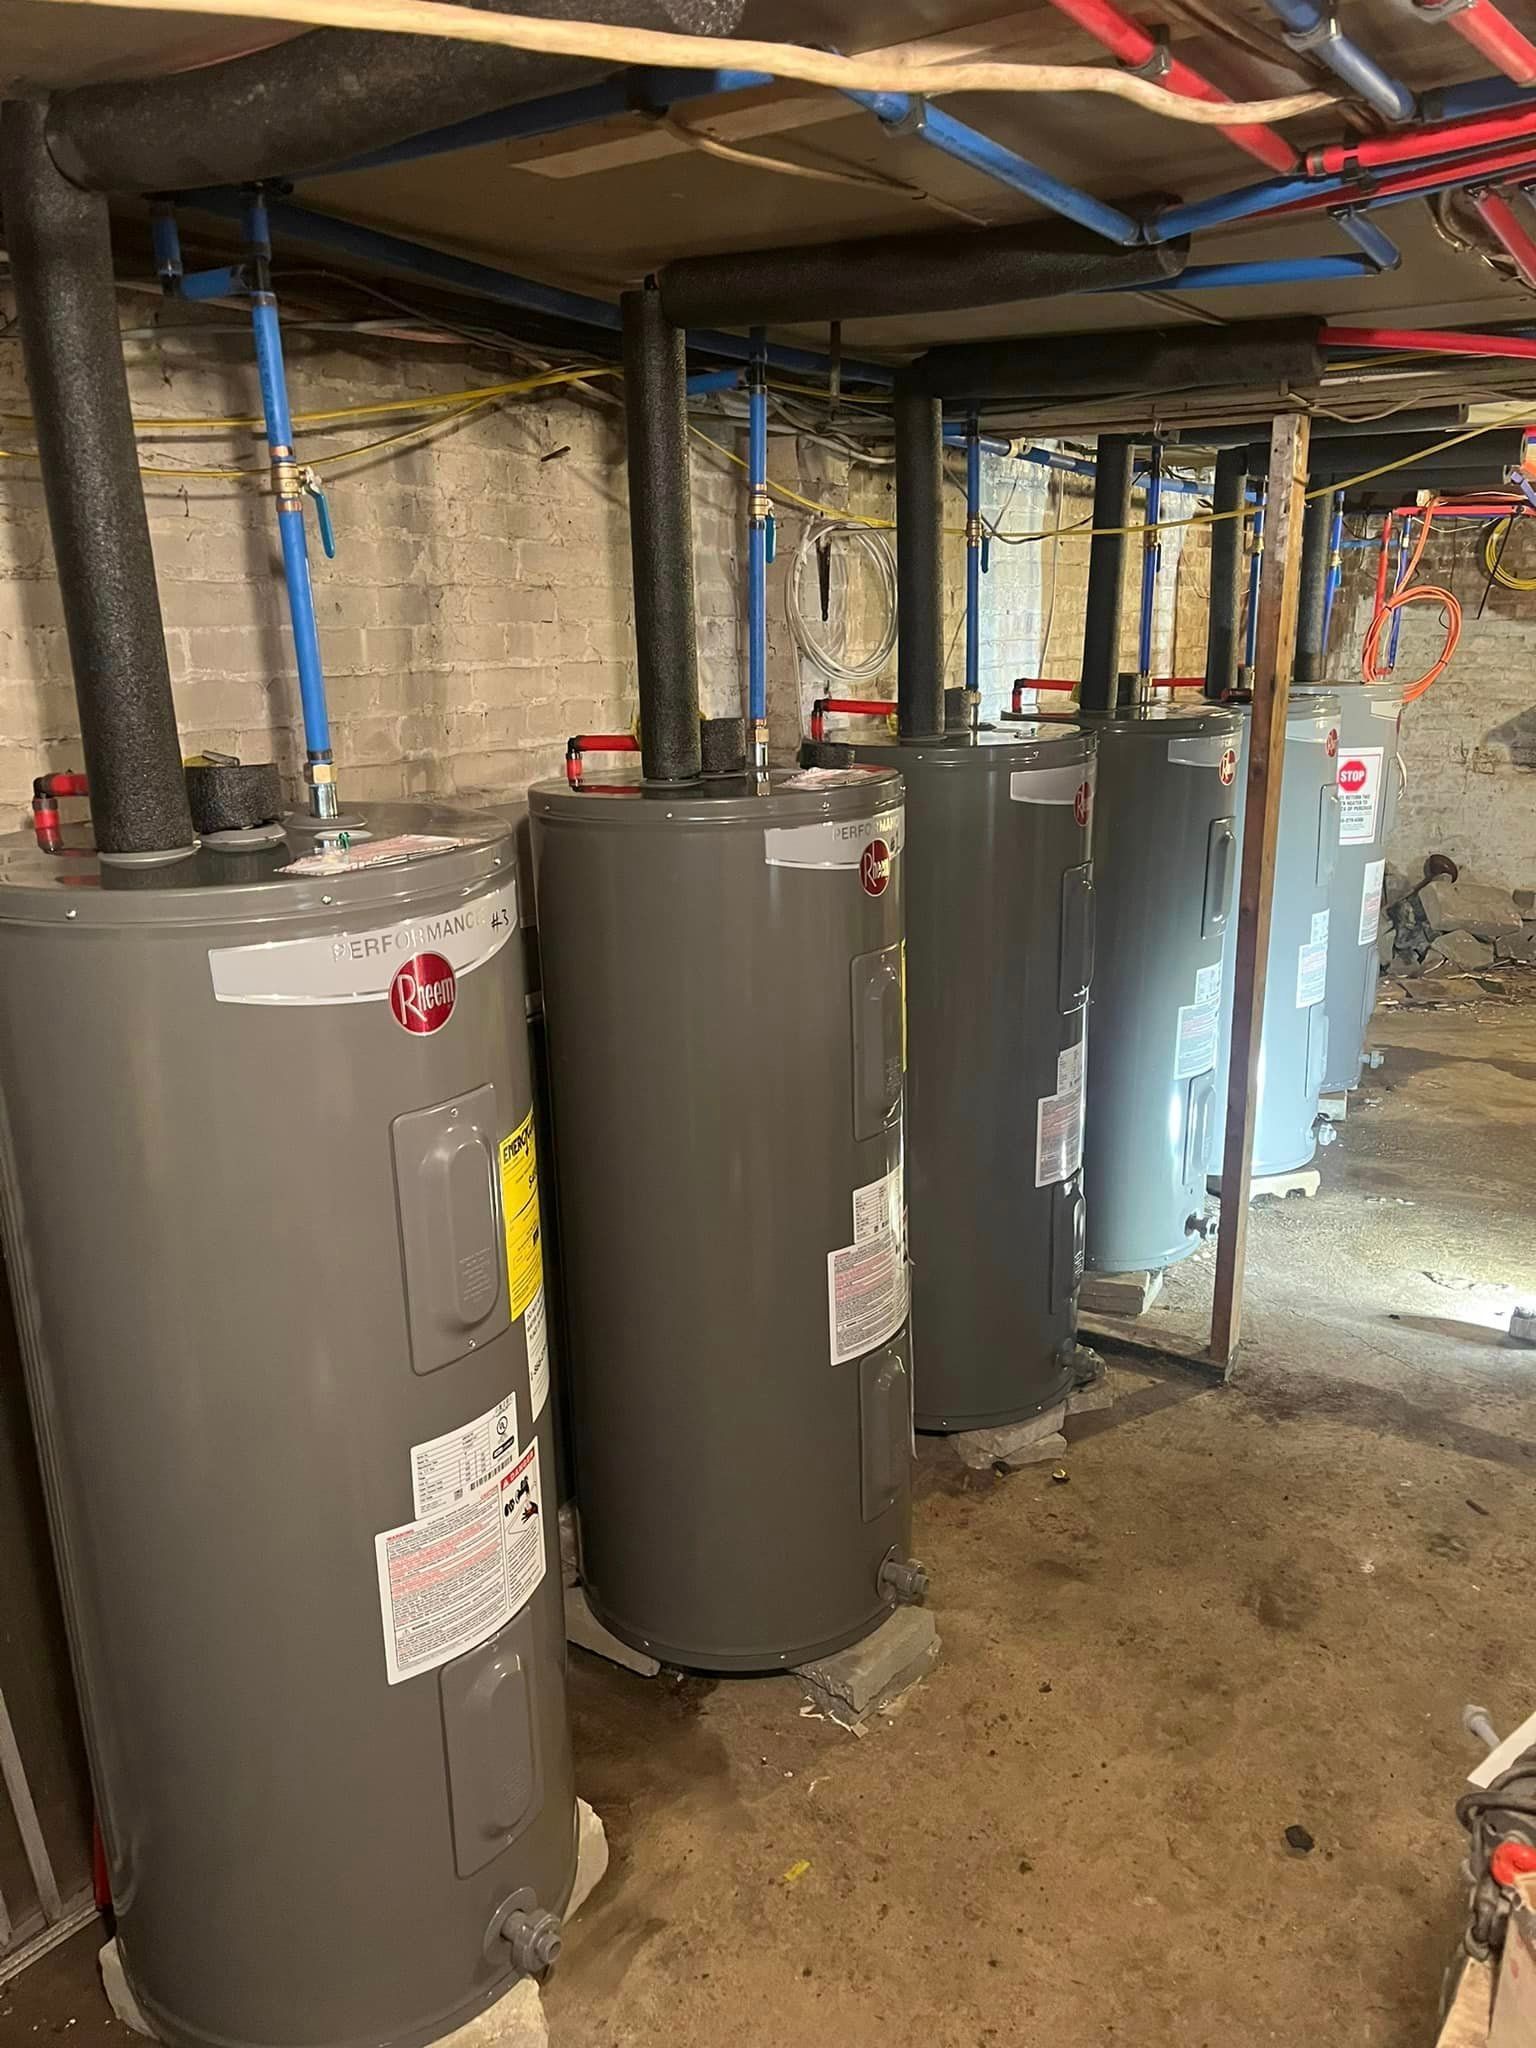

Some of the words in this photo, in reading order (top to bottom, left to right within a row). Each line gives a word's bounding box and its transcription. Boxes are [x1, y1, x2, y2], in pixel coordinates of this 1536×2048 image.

[1340, 770, 1365, 782] STOP
[490, 908, 509, 932] #3
[397, 958, 455, 1025] Rheem
